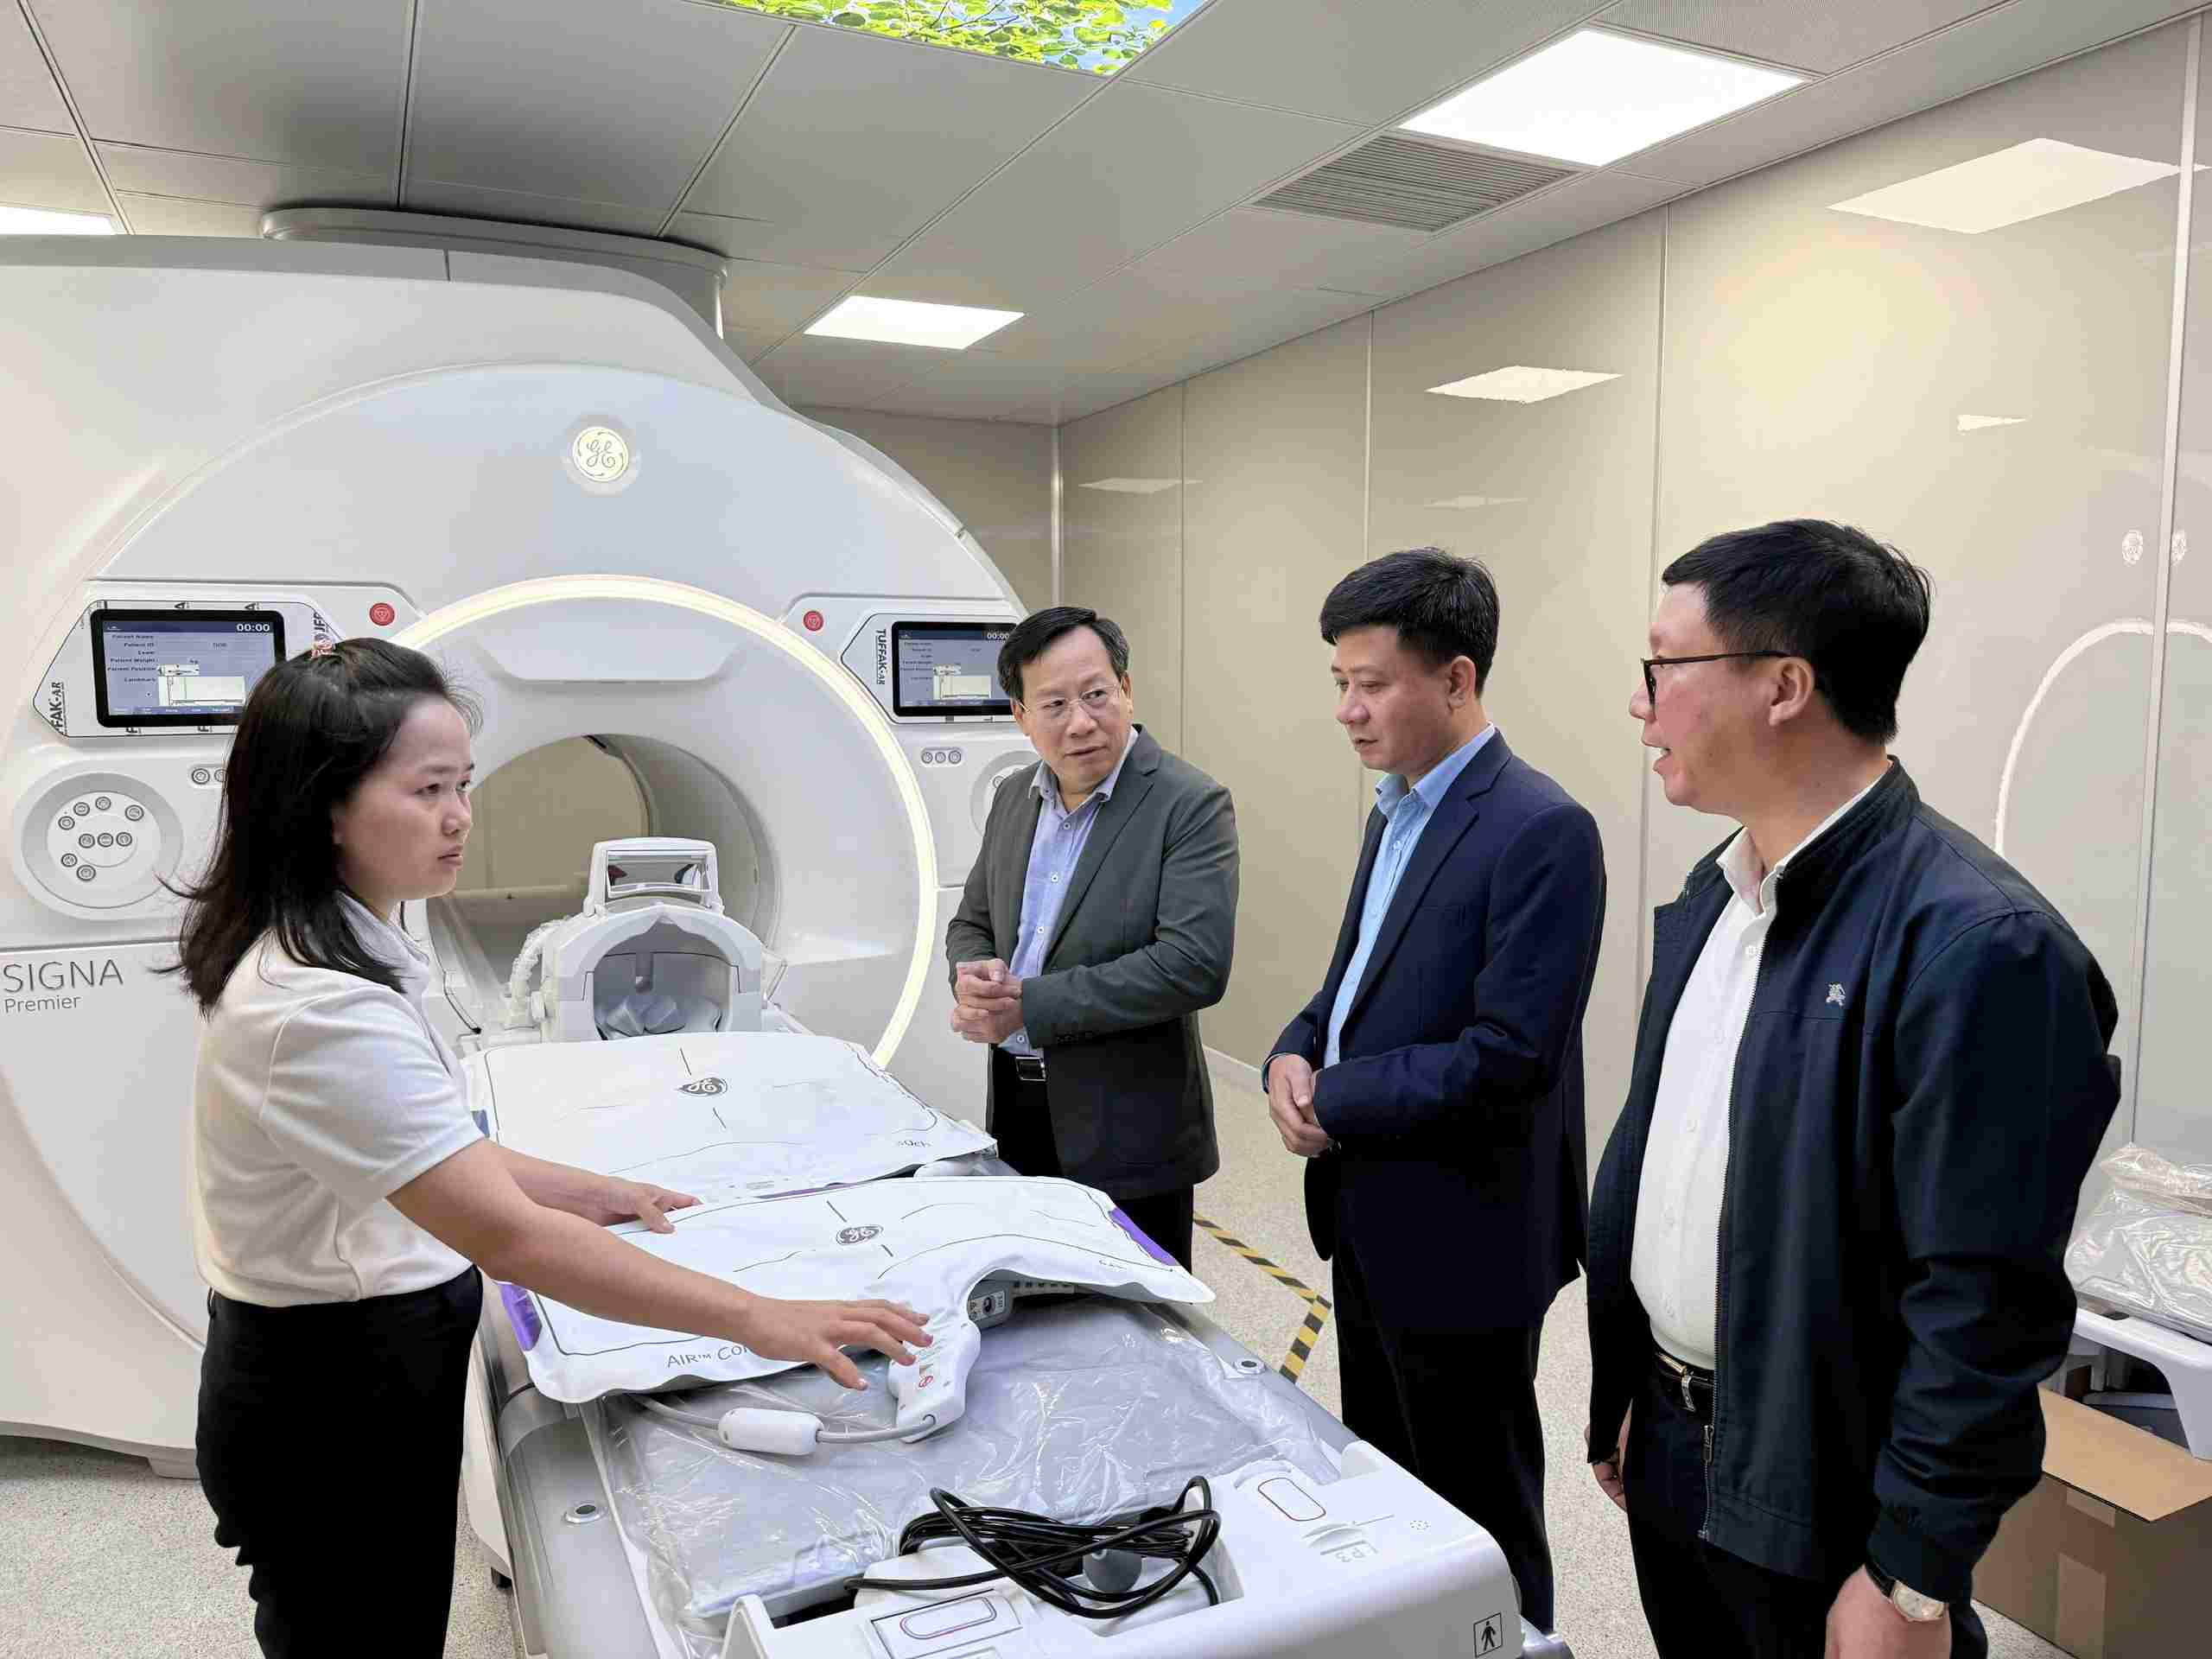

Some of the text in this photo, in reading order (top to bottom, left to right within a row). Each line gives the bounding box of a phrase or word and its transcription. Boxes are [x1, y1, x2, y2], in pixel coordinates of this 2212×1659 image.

[236, 623, 270, 632] 00:00
[3, 959, 124, 994] SIGNA
[5, 995, 81, 1014] Premier
